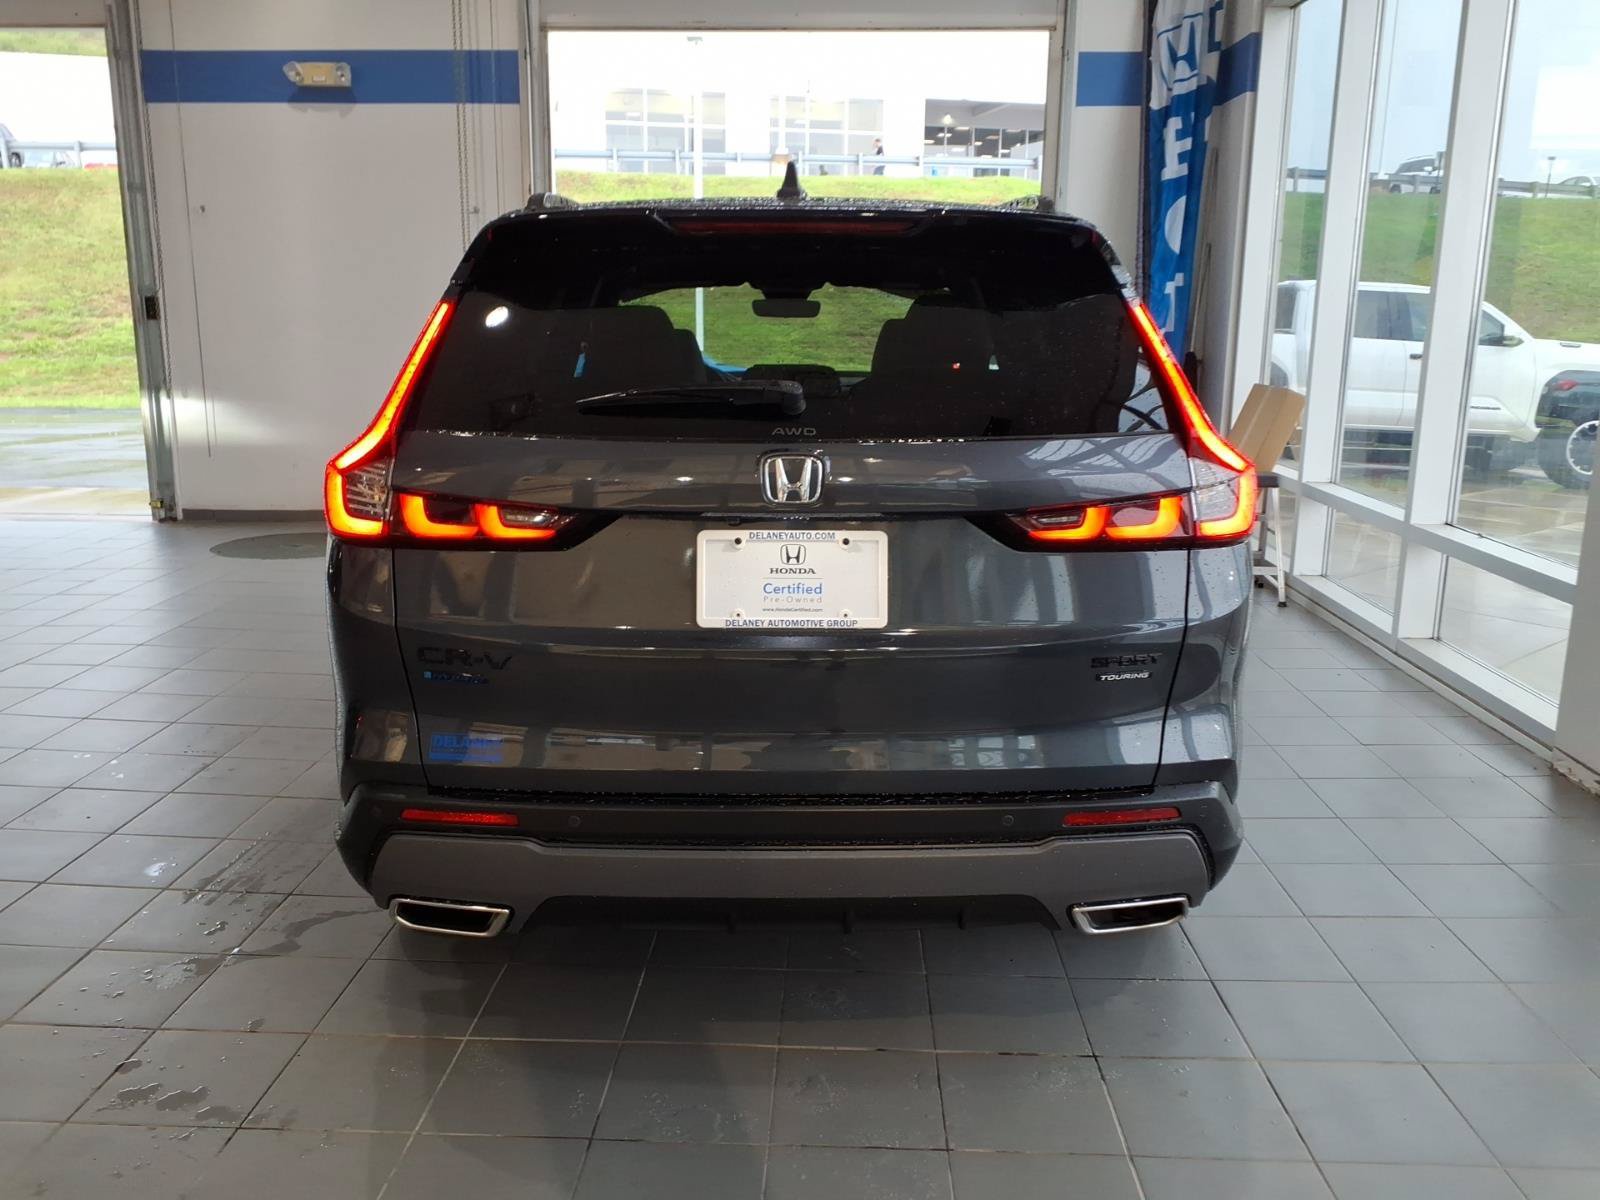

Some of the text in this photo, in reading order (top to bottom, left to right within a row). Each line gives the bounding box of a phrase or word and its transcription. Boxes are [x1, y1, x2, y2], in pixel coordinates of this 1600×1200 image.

[771, 427, 816, 436] AWD
[749, 531, 836, 540] DELANEYAUTO.COM
[769, 567, 816, 575] HONDA
[763, 582, 823, 595] Certified
[763, 595, 823, 604] Pre-Owned
[725, 619, 858, 628] DELANEY AUTOMOTIVE GROUP
[418, 646, 513, 670] CR-V
[1100, 671, 1150, 681] TOURING
